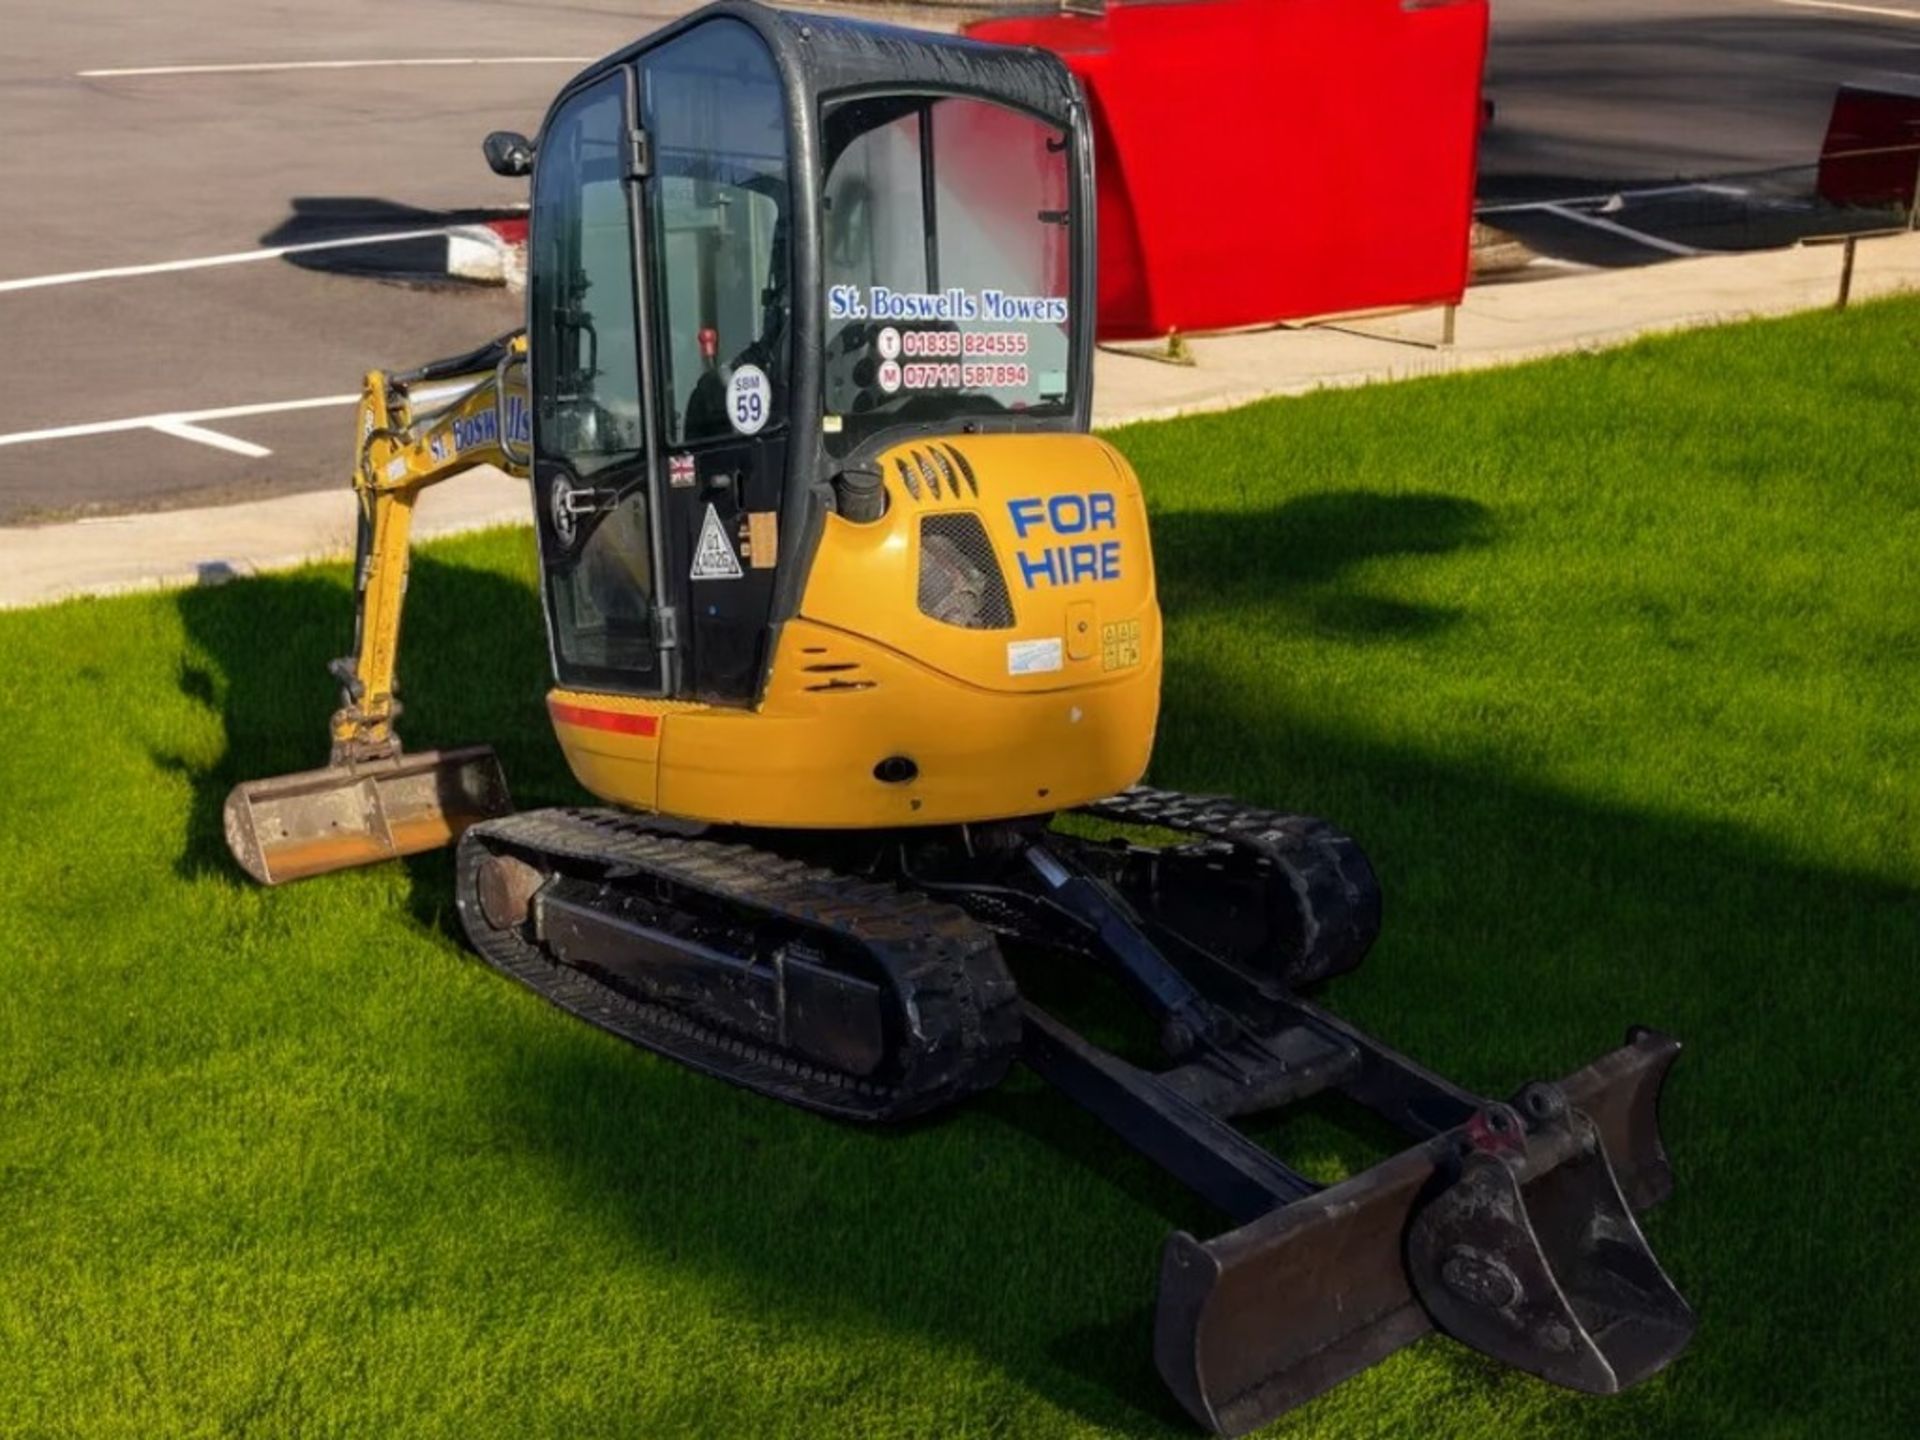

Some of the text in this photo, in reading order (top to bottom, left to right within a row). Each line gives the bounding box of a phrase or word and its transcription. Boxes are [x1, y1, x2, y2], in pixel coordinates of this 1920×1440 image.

[830, 286, 1067, 322] St. Boswells Mowers
[904, 333, 959, 354] 01835
[965, 334, 1026, 353] 824555
[736, 376, 760, 391] SBM
[904, 365, 959, 385] 07711
[965, 366, 1026, 384] 587894
[453, 395, 530, 451] Boswlls
[737, 392, 761, 423] 59
[1007, 493, 1116, 539] FOR
[1017, 542, 1120, 589] HIRE
